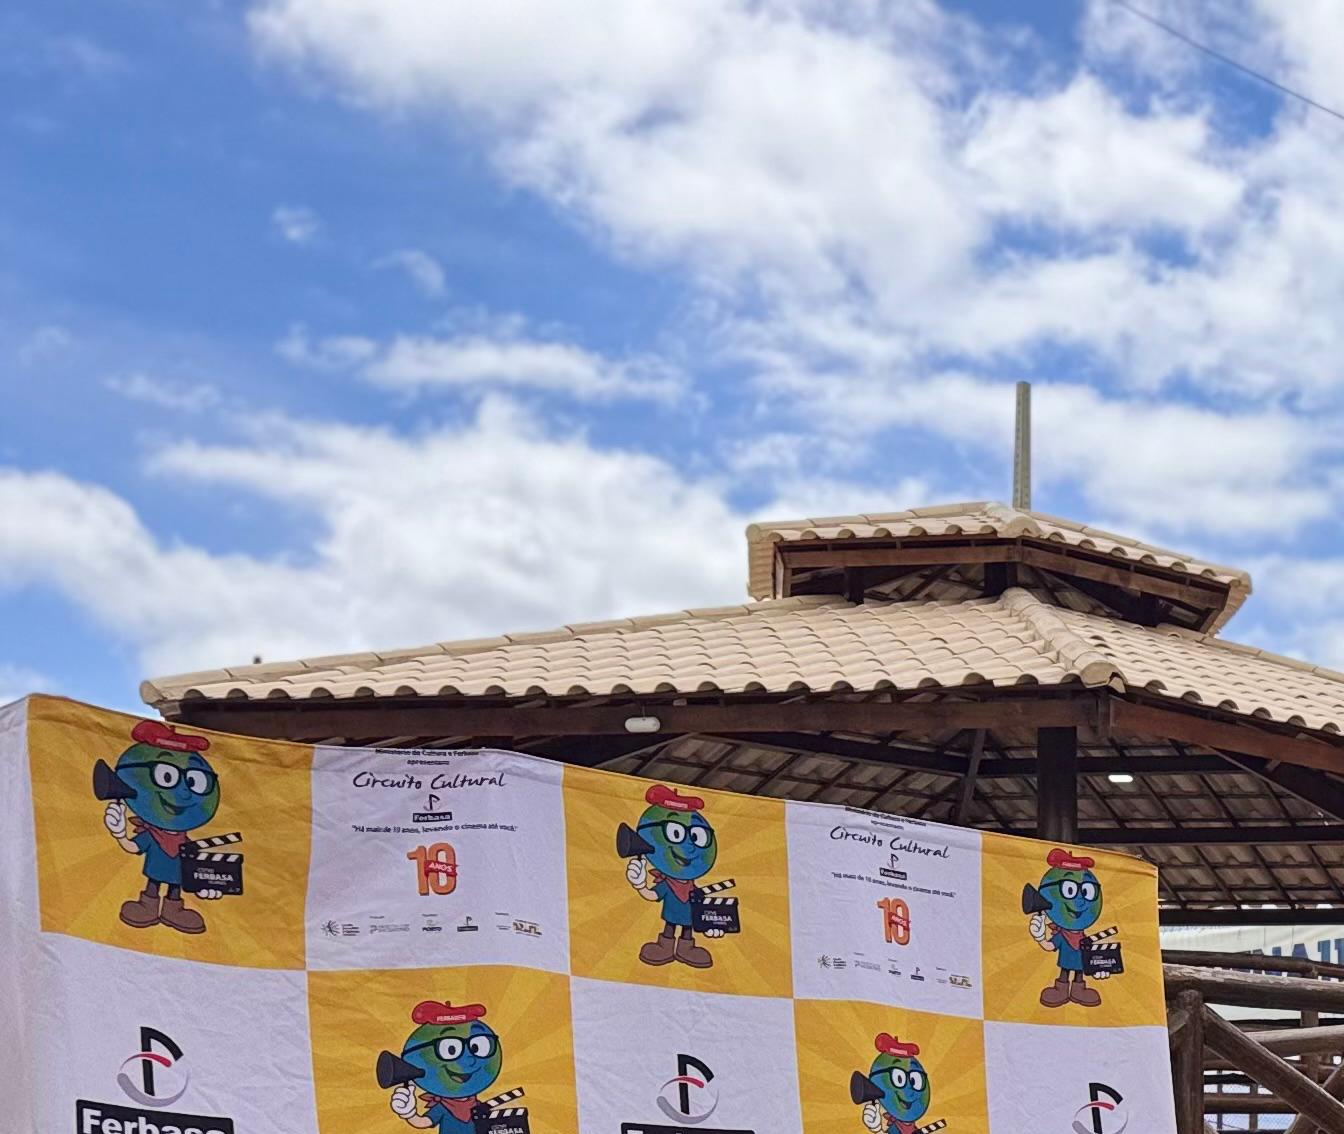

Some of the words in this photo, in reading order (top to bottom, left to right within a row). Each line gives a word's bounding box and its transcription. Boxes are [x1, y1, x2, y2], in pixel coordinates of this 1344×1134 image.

[352, 771, 422, 790] Circuito
[430, 772, 508, 790] Cultural
[829, 825, 883, 847] Circuito
[889, 836, 950, 859] Cultural
[193, 871, 234, 882] FERBASA
[407, 842, 457, 897] 10
[428, 862, 454, 873] ANOS
